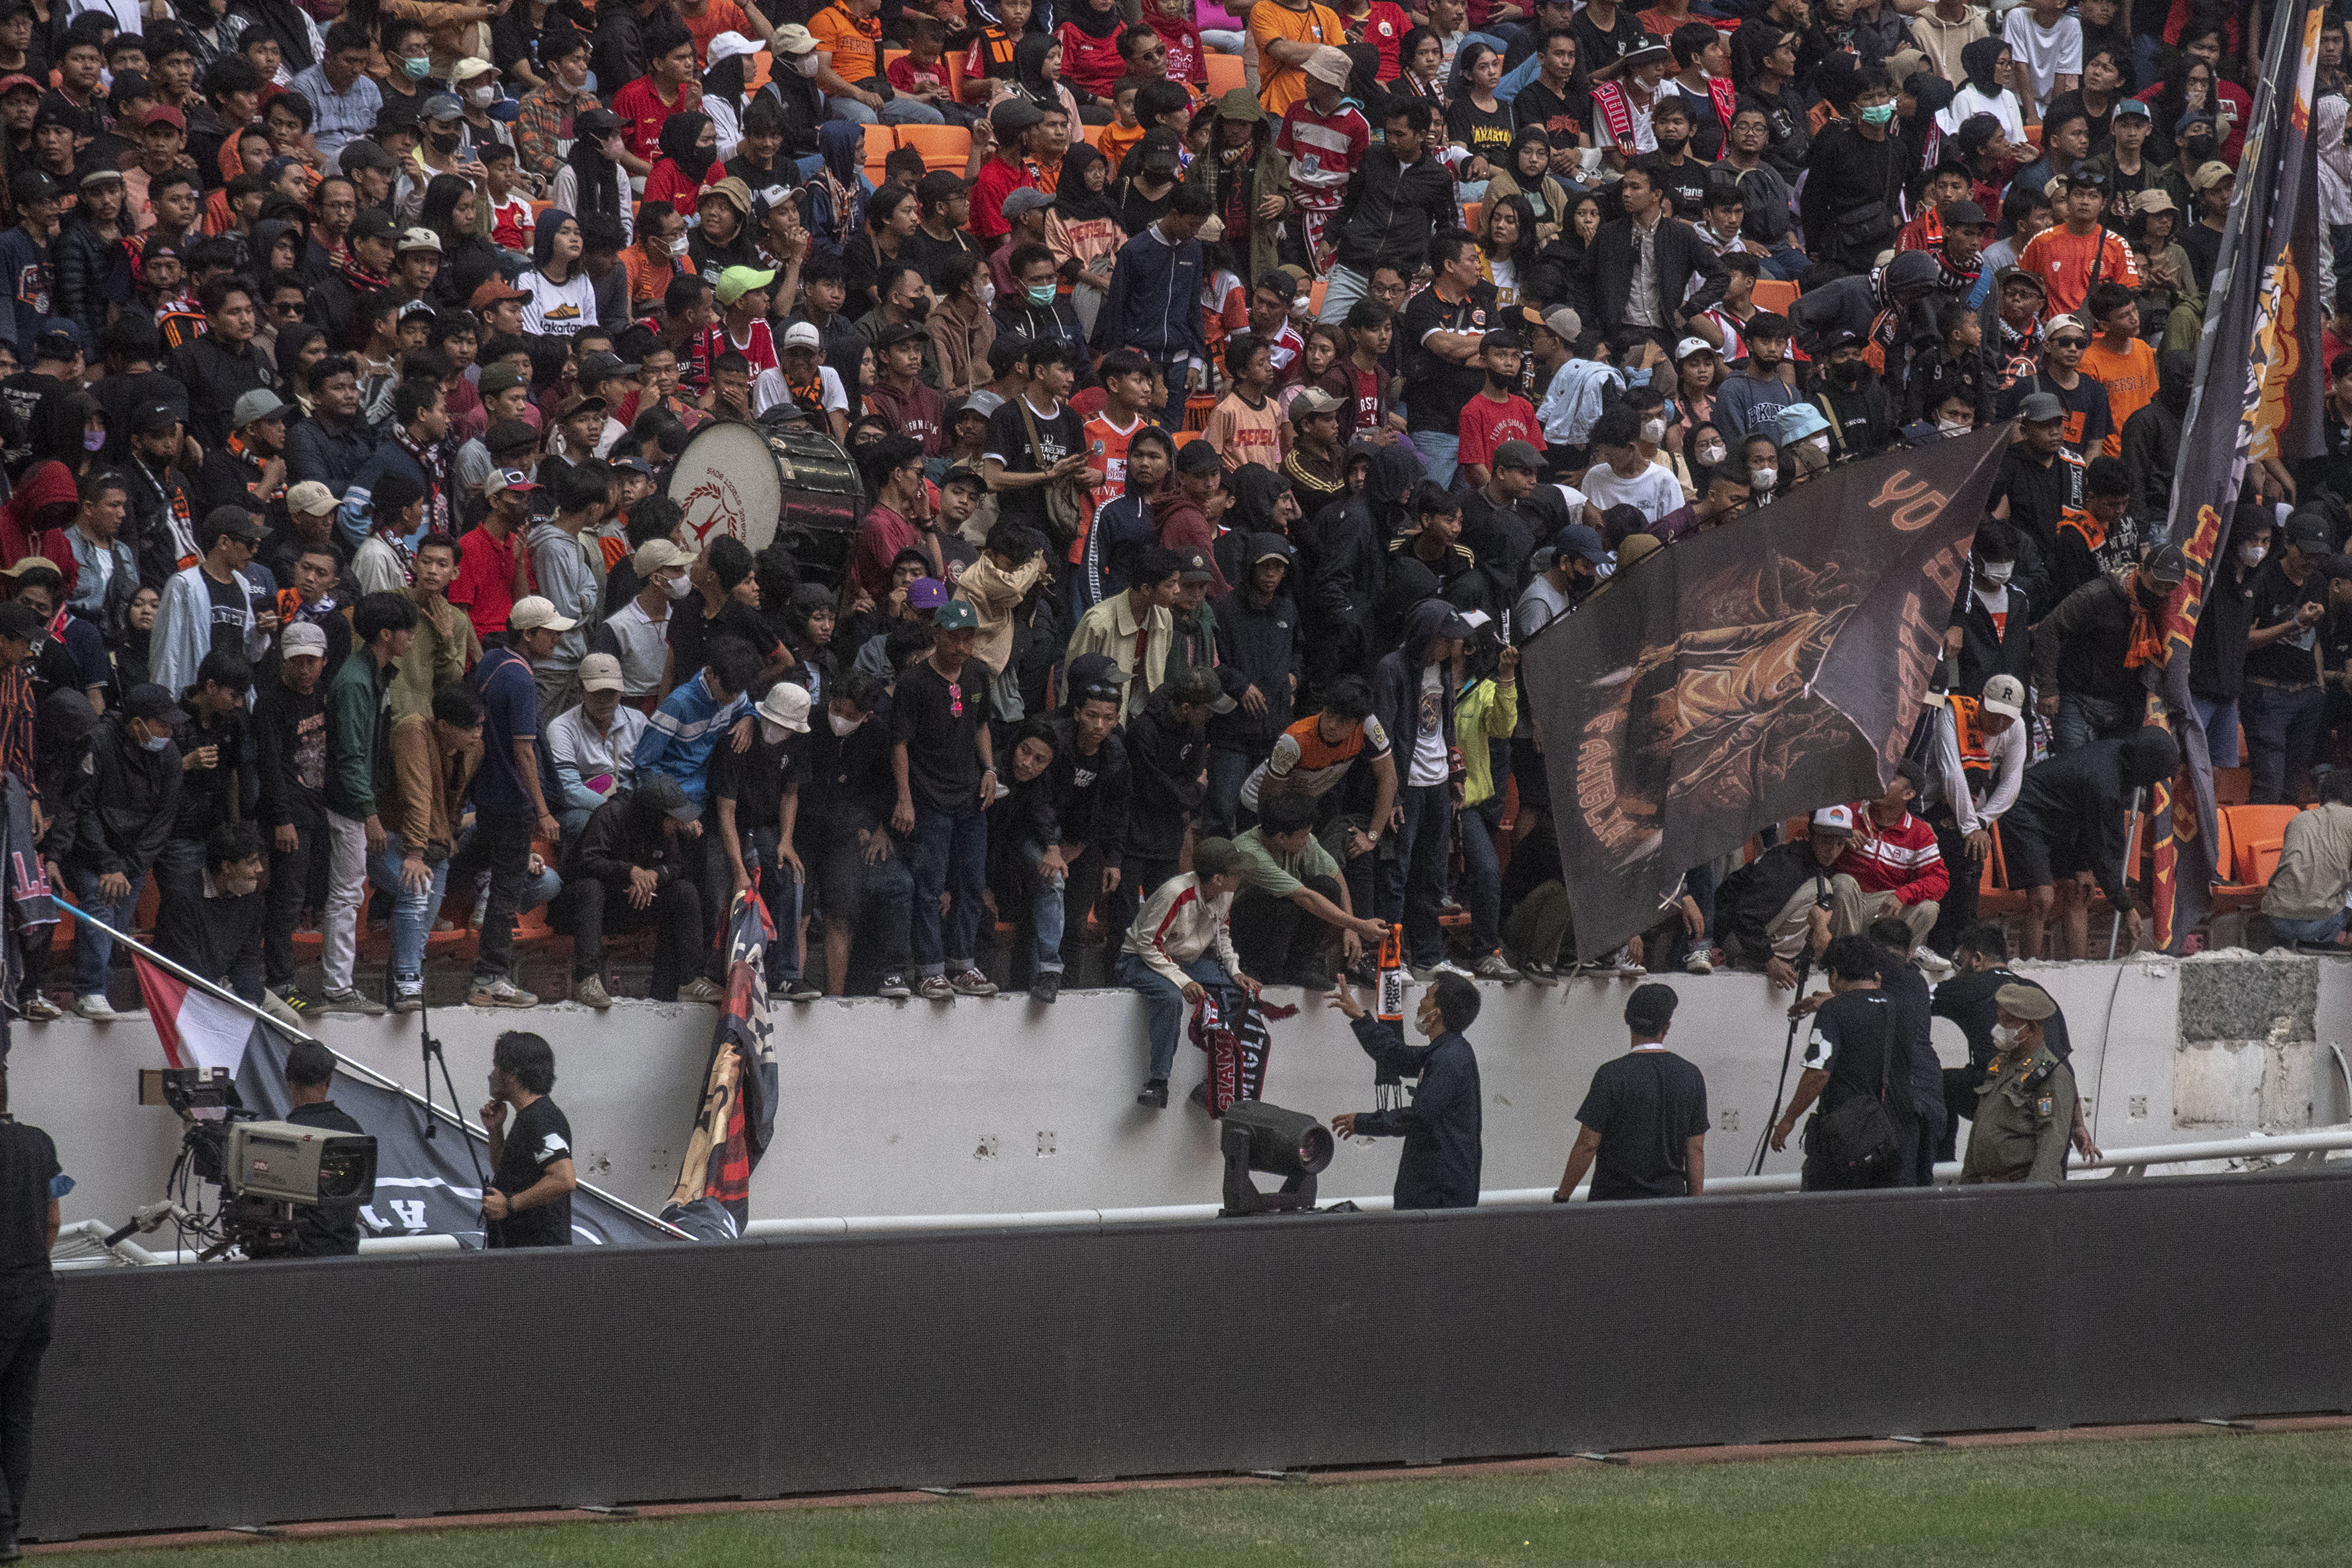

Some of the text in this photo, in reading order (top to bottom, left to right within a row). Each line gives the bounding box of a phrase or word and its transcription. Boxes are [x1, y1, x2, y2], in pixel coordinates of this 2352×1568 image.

[1934, 365, 1942, 380] 9
[1090, 486, 1118, 497] ANK
[2002, 687, 2013, 701] R
